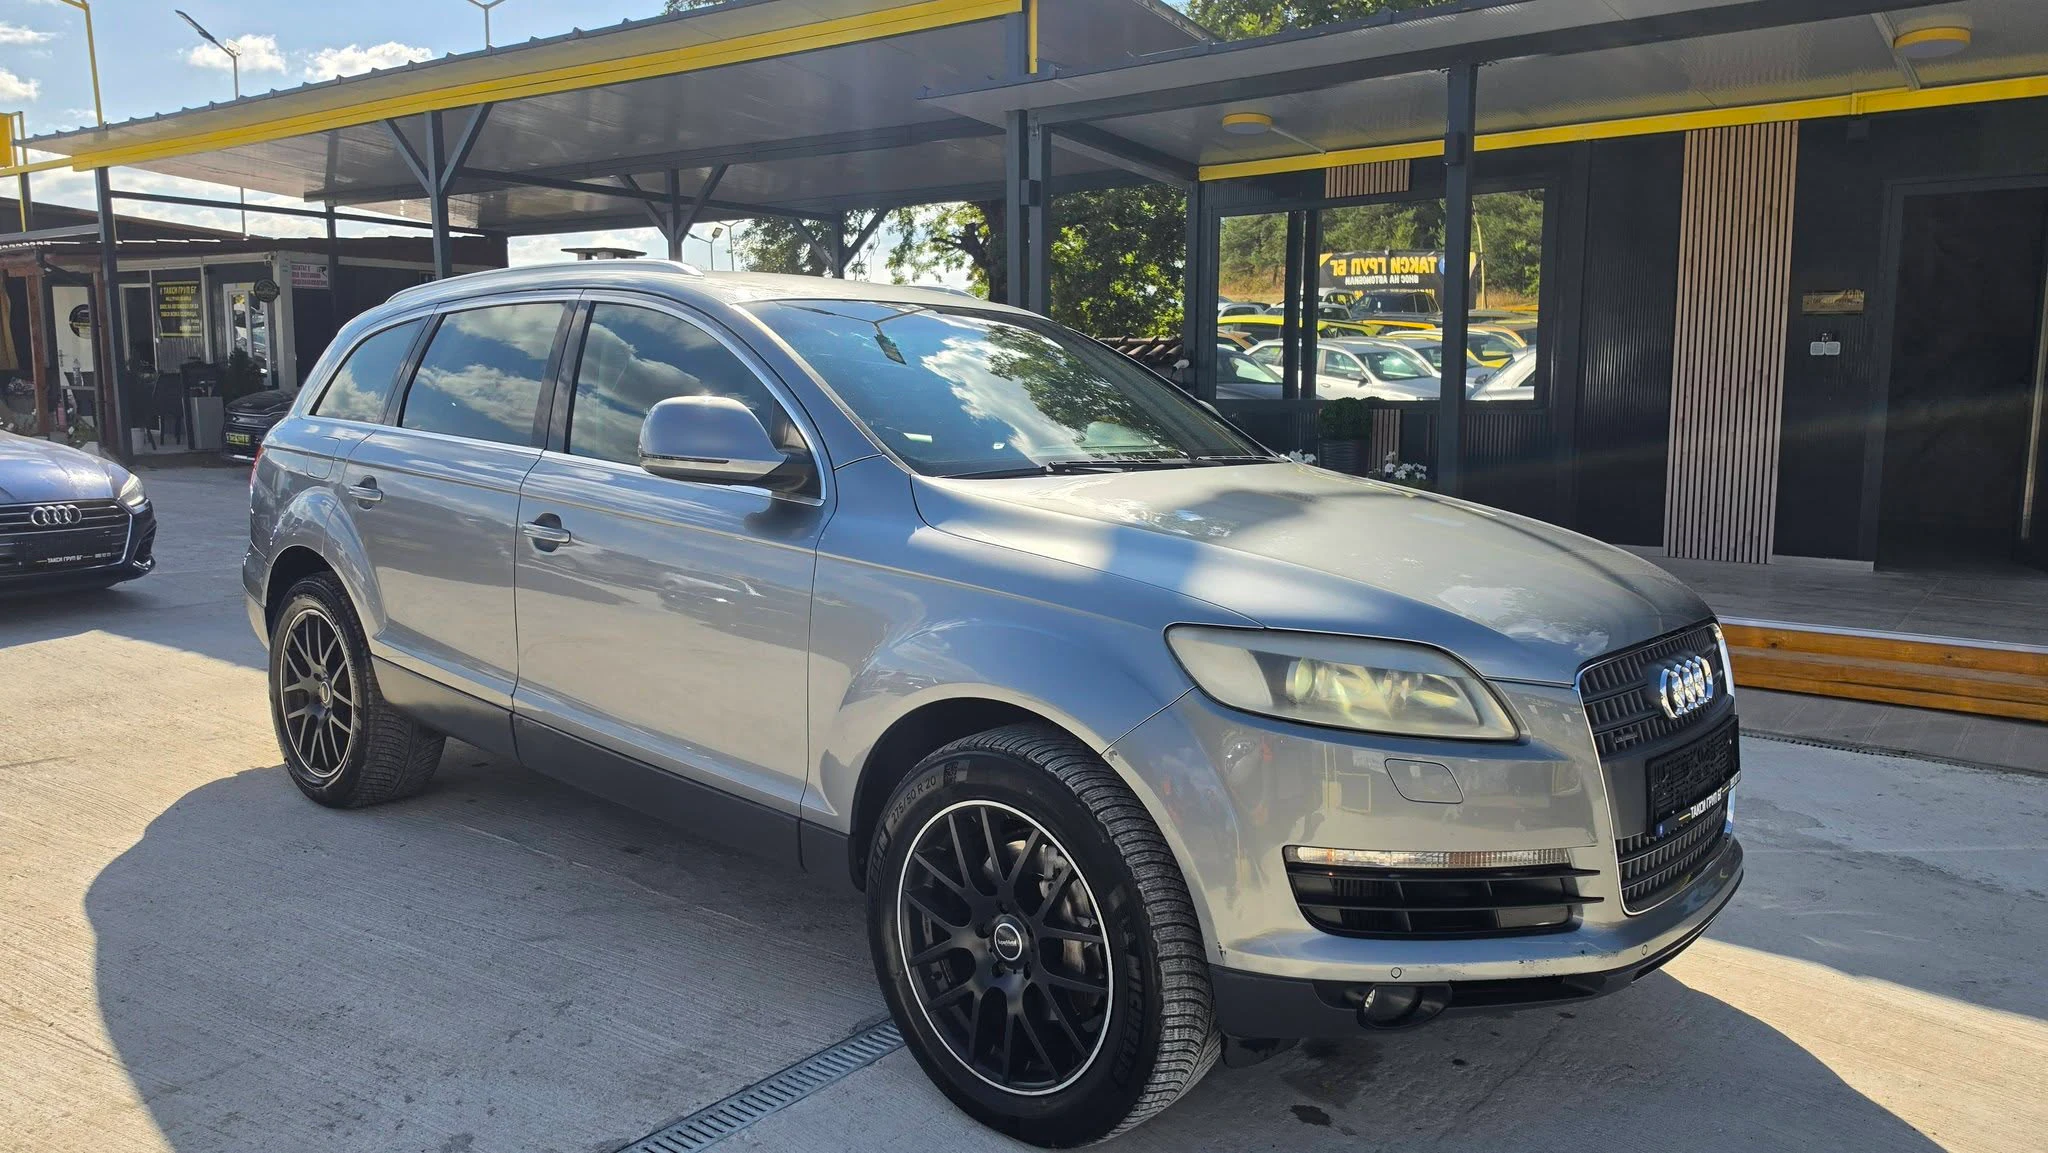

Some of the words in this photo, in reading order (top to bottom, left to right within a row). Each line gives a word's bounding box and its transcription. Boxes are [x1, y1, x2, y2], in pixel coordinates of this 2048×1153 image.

[917, 783, 924, 793] R
[925, 775, 937, 789] 20
[1690, 799, 1707, 819] ТАКСИ
